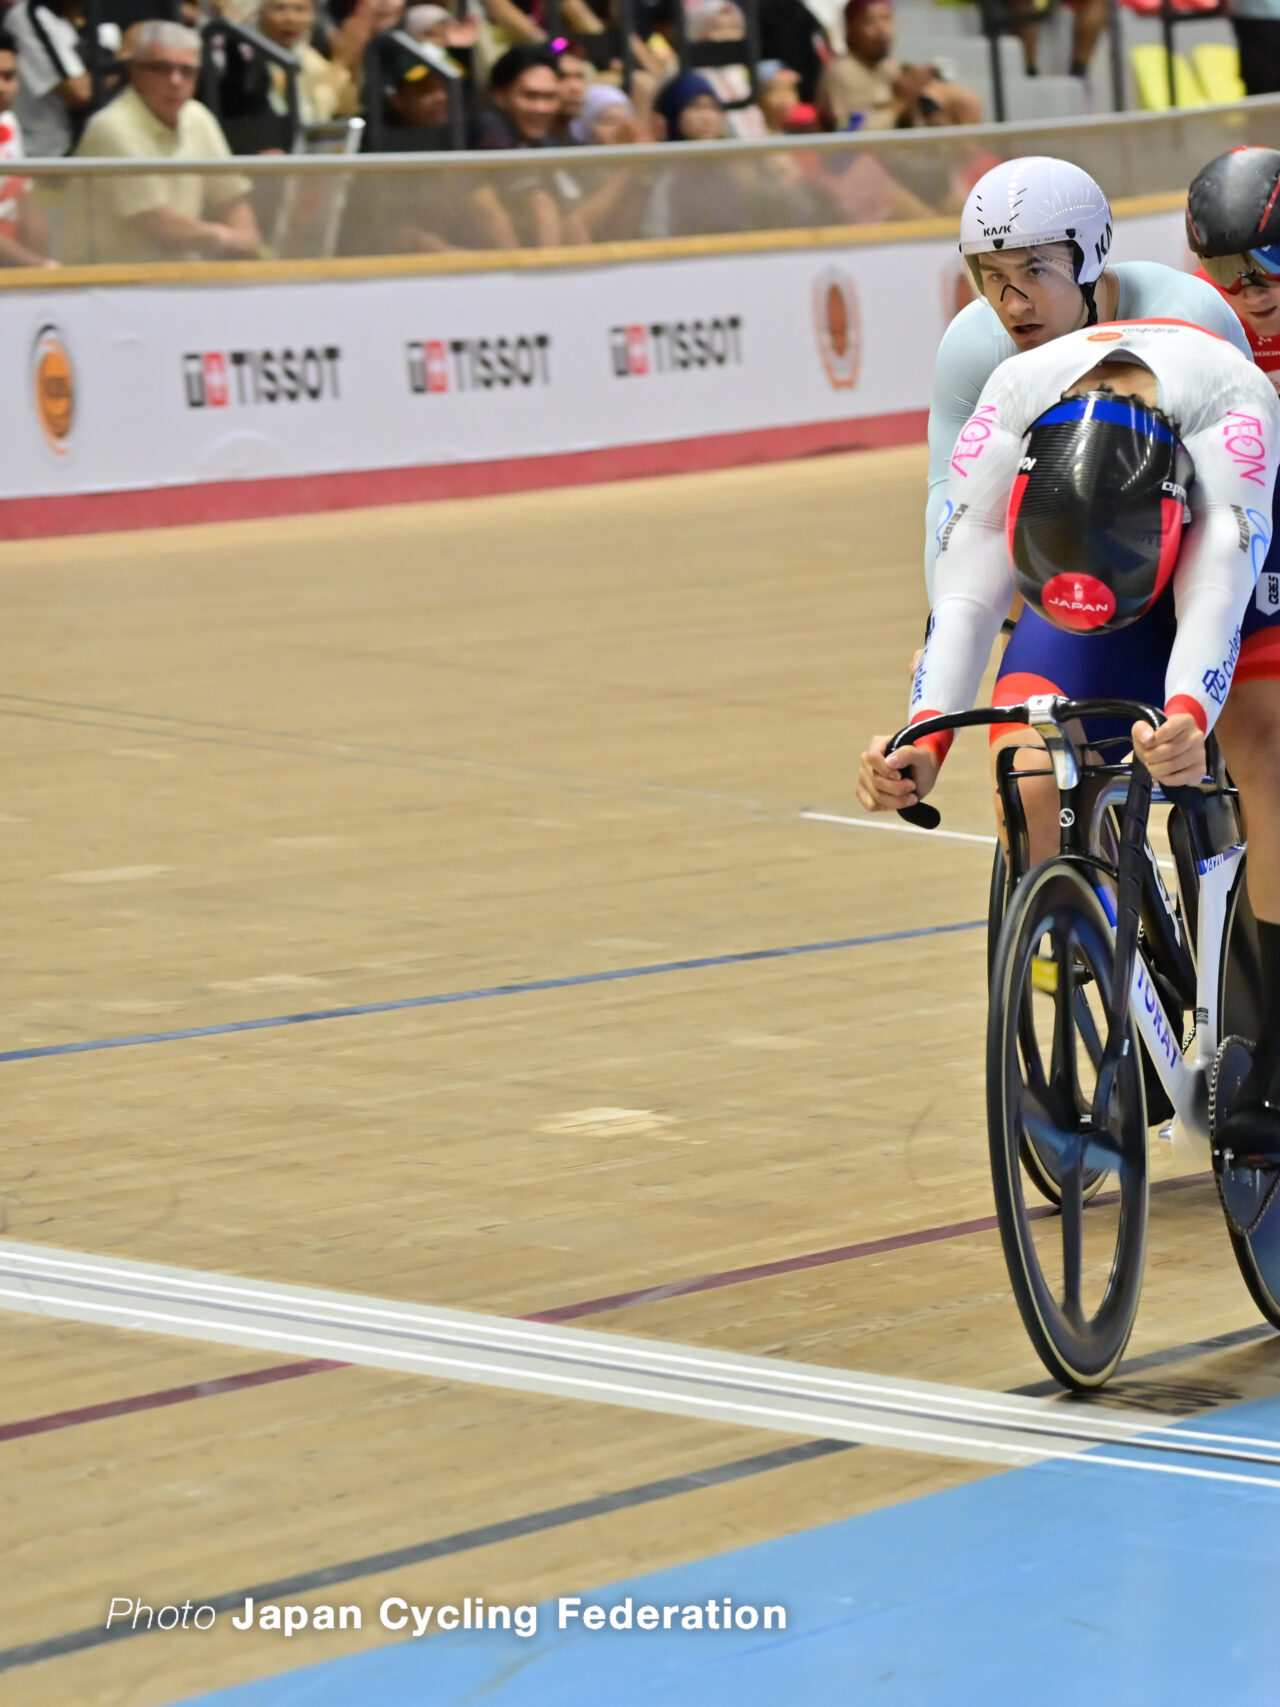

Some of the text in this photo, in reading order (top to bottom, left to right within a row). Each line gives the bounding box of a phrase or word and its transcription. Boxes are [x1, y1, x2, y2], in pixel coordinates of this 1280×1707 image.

[449, 333, 551, 393] TISSOT
[650, 315, 742, 374] TISSOT
[230, 346, 340, 405] TISSOT
[942, 503, 969, 552] KEIRIN
[1230, 503, 1250, 553] KEIRIN
[1048, 598, 1108, 611] JAPAN
[1137, 966, 1178, 1069] TORAY
